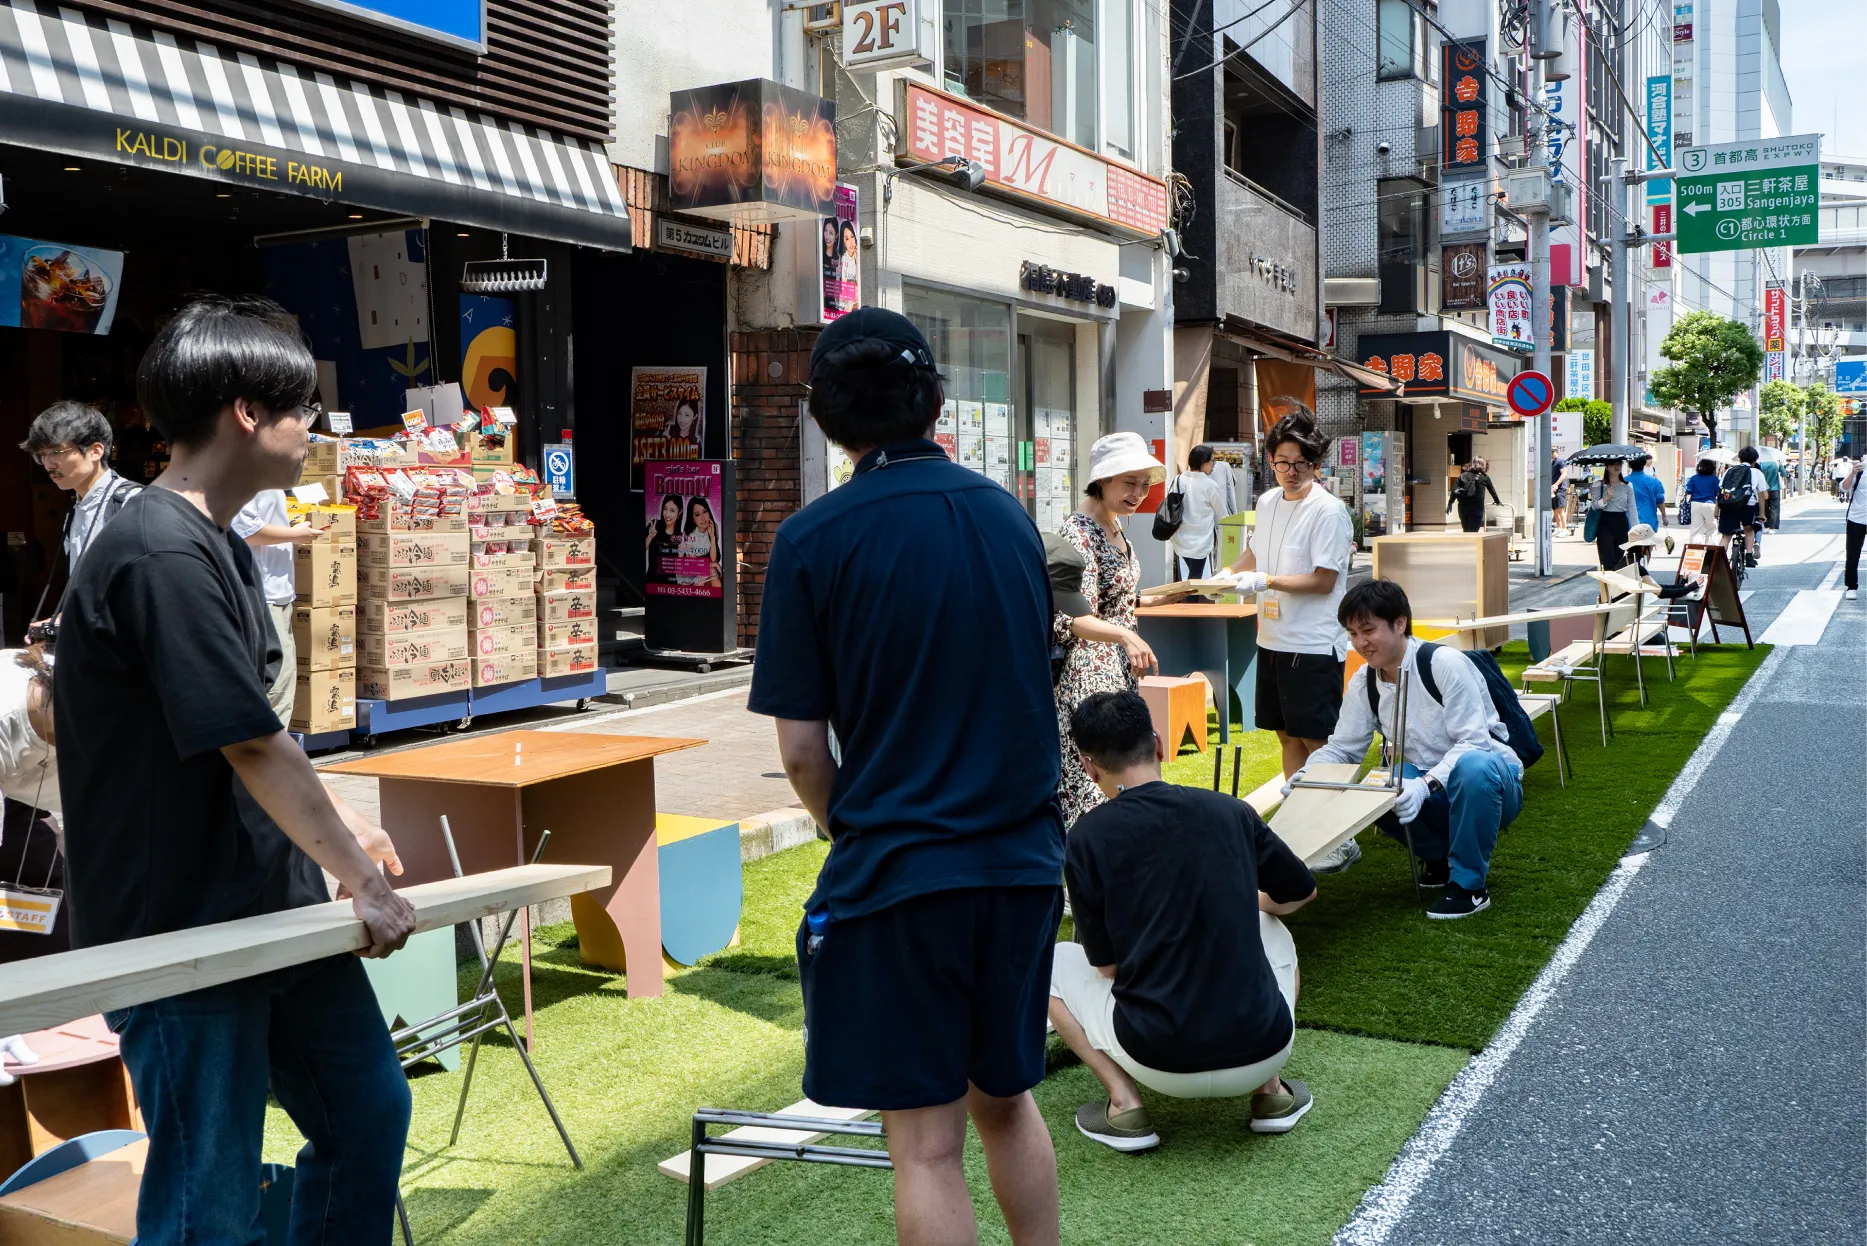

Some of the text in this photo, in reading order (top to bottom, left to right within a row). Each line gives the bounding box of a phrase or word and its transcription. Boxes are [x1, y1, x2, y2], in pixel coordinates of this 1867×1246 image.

[852, 2, 906, 54] 2F
[915, 96, 995, 173] 美容室
[1651, 82, 1667, 172] 河合塾マナビス
[705, 139, 726, 149] CLUB
[1763, 142, 1814, 153] SHUTOKO
[116, 127, 342, 192] KALDI COFFEE FARM
[678, 150, 753, 173] KINGDOM
[1691, 153, 1700, 167] 3
[1713, 148, 1758, 165] 首都高
[1764, 150, 1812, 160] EXPWY
[768, 151, 831, 180] KINGDOM
[1681, 184, 1713, 196] 500m
[1720, 184, 1742, 196] 入口
[1747, 175, 1809, 195] 三軒茶屋
[1720, 197, 1742, 208] 305
[1747, 194, 1815, 209] Sangenjaya
[1720, 222, 1734, 235] C1
[1741, 214, 1811, 231] 都心環状方面
[1659, 211, 1667, 261] 三井のハウス
[1741, 229, 1787, 241] Circle 1
[1507, 289, 1518, 319] 良い店
[1519, 290, 1529, 320] いい町
[1494, 291, 1506, 336] いい商店街
[1770, 290, 1780, 338] サンドラッグ
[1769, 340, 1781, 350] 薬
[1570, 353, 1578, 399] 三軒茶屋分
[635, 384, 699, 400] 全員サービスタイム
[686, 464, 700, 474] bar
[552, 475, 566, 484] 駐輪
[552, 484, 566, 493] 禁止
[653, 473, 712, 497] Bounty
[569, 542, 581, 564] 辛
[568, 569, 579, 589] 辛
[667, 586, 711, 597] 03-5433-4666
[571, 596, 583, 618] 辛
[571, 622, 583, 644] 辛
[573, 648, 584, 671] 辛
[7, 910, 47, 923] STAFF
